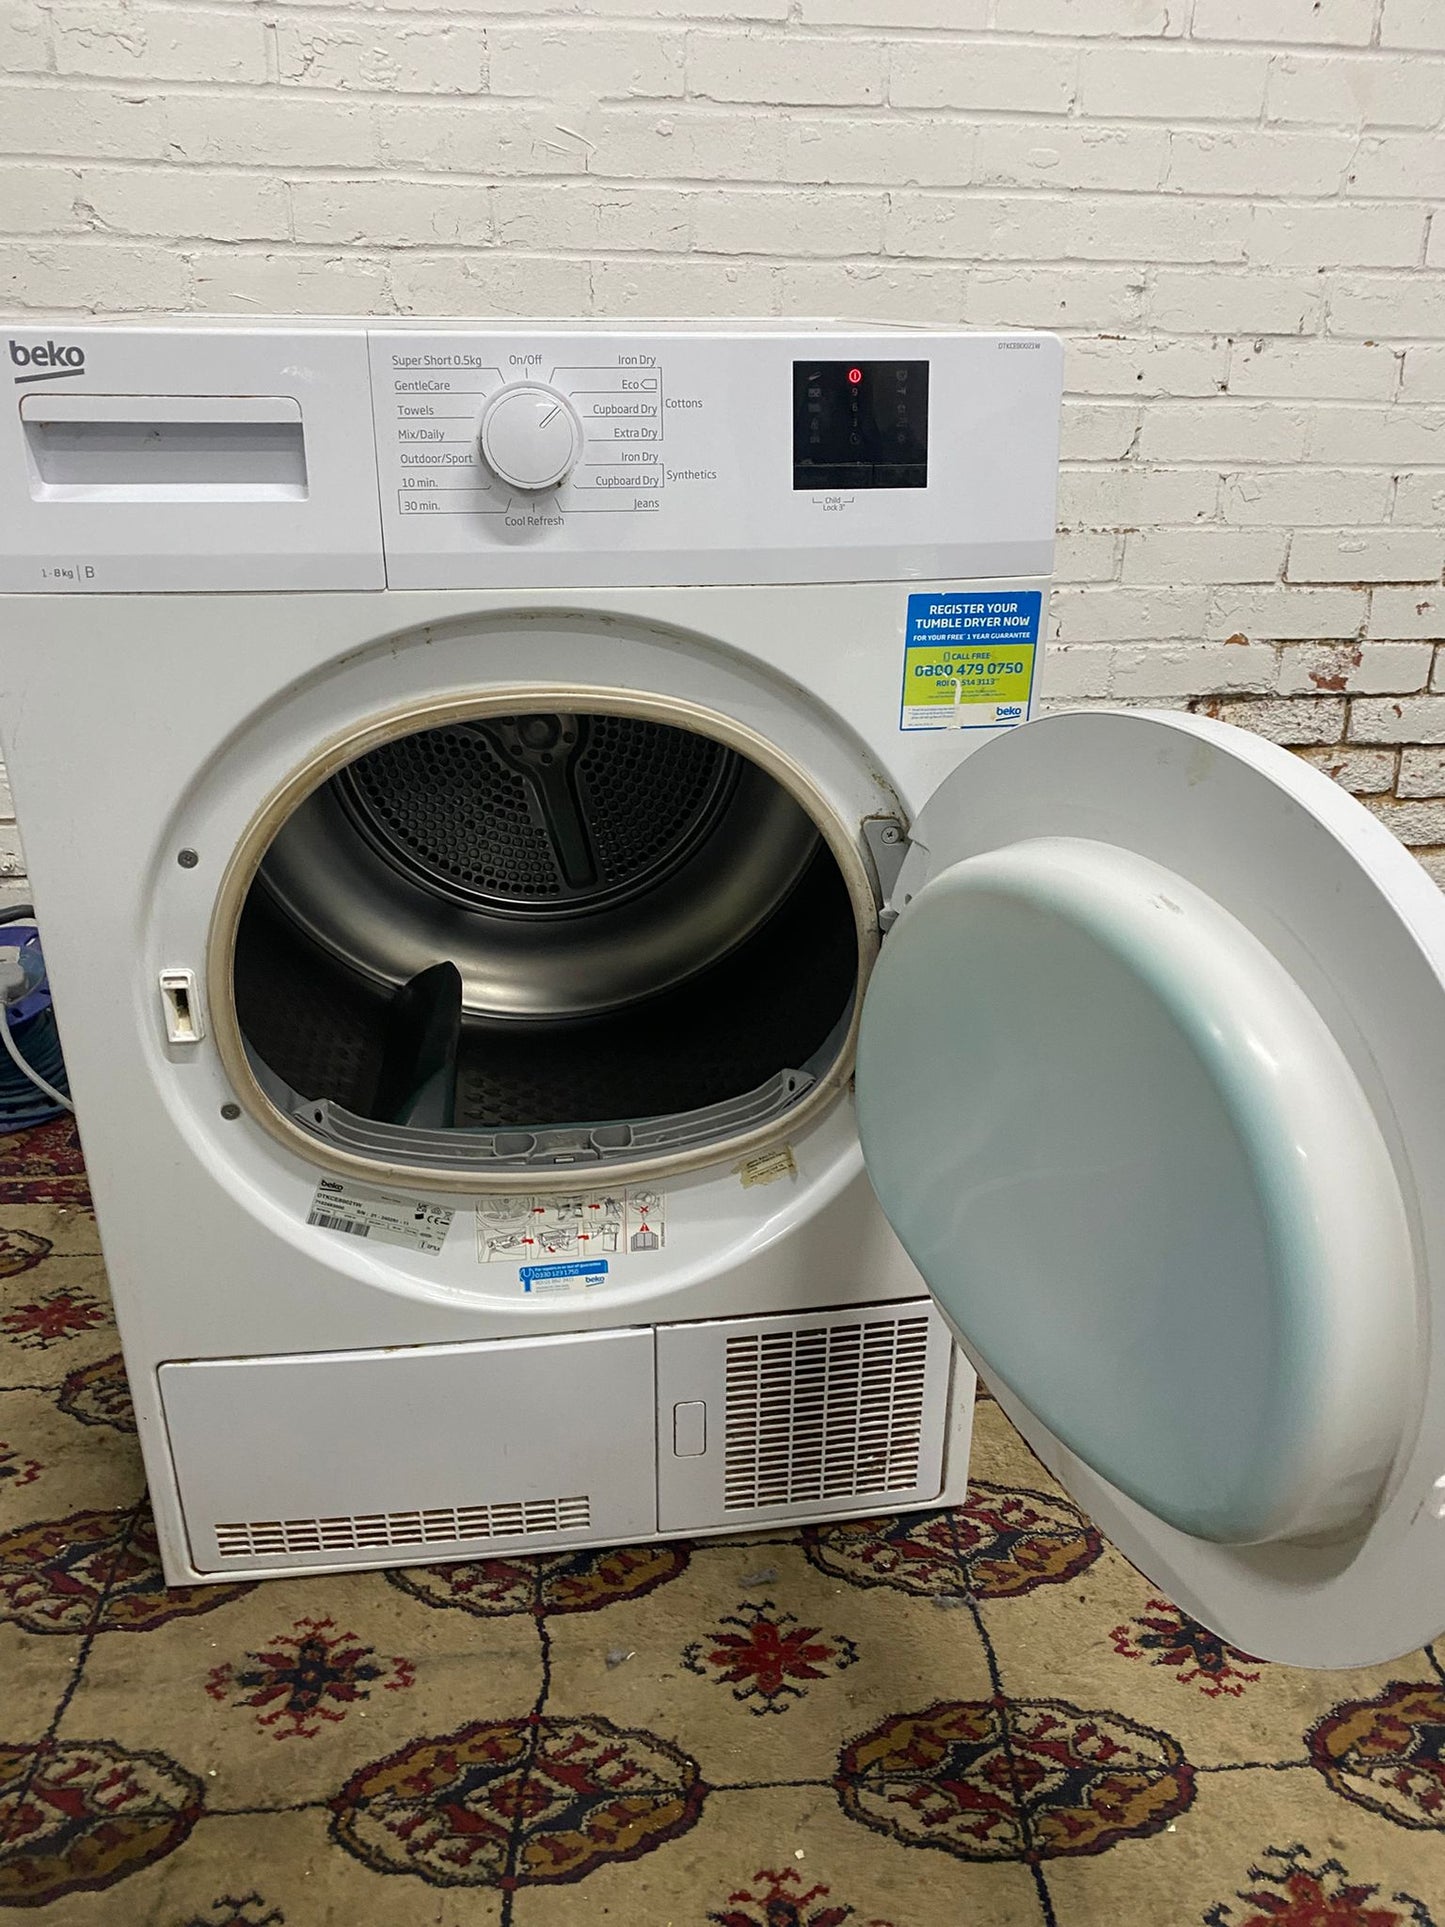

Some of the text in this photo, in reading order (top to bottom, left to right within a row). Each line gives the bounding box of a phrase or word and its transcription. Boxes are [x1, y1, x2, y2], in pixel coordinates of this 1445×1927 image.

[9, 340, 85, 366] beko
[392, 355, 482, 366] Super Short 0.5kg
[509, 354, 542, 365] On/Off
[618, 355, 657, 367] Iron Dry
[394, 381, 450, 391] GentleCare
[622, 380, 639, 390] Eco
[665, 398, 703, 408] Cottons
[397, 405, 434, 416] Towels
[593, 404, 658, 416] Cupboard Dry
[398, 429, 445, 441] Mix/Daily
[614, 428, 658, 440] Extra Dry
[400, 454, 472, 466] Outdoor/Sport
[621, 452, 659, 464] Iron Dry
[666, 469, 717, 482] Synthetics
[402, 478, 439, 488] 10 min.
[595, 476, 660, 488] Cupboard Dry
[633, 499, 660, 510] Jeans
[825, 496, 841, 504] Child
[404, 501, 440, 511] 30 min.
[505, 515, 565, 526] Cool Refresh
[85, 566, 95, 578] B
[929, 603, 1018, 615] REGISTER YOUR
[915, 616, 1030, 629] TUMBLE DRYER NOW
[971, 652, 991, 660] FREE
[915, 662, 1023, 677] 0800 479 0750
[996, 707, 1022, 716] beko
[320, 1179, 344, 1191] beko
[585, 1275, 605, 1283] beko
